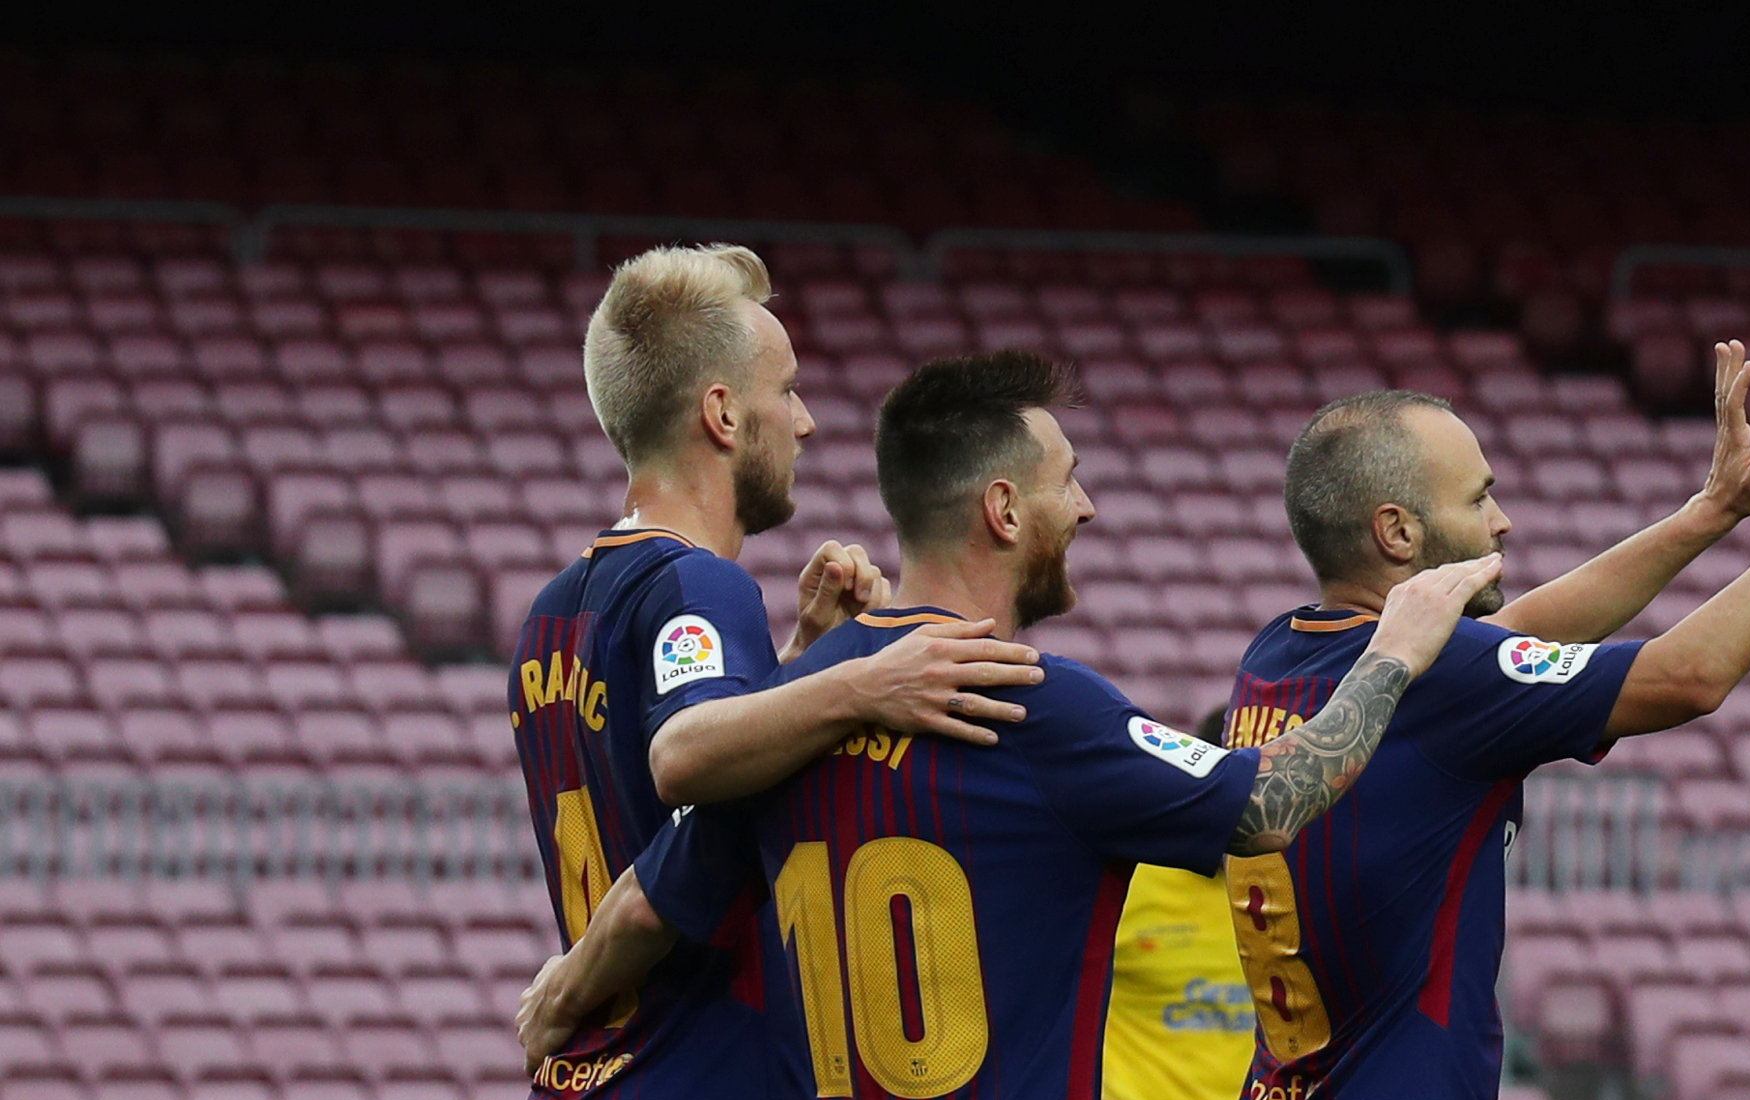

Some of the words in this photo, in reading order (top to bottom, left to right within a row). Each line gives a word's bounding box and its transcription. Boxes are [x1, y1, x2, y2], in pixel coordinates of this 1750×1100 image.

[662, 664, 716, 682] LaLiga
[555, 785, 640, 1028] 4
[774, 836, 989, 1099] 10
[1222, 852, 1331, 1064] 8
